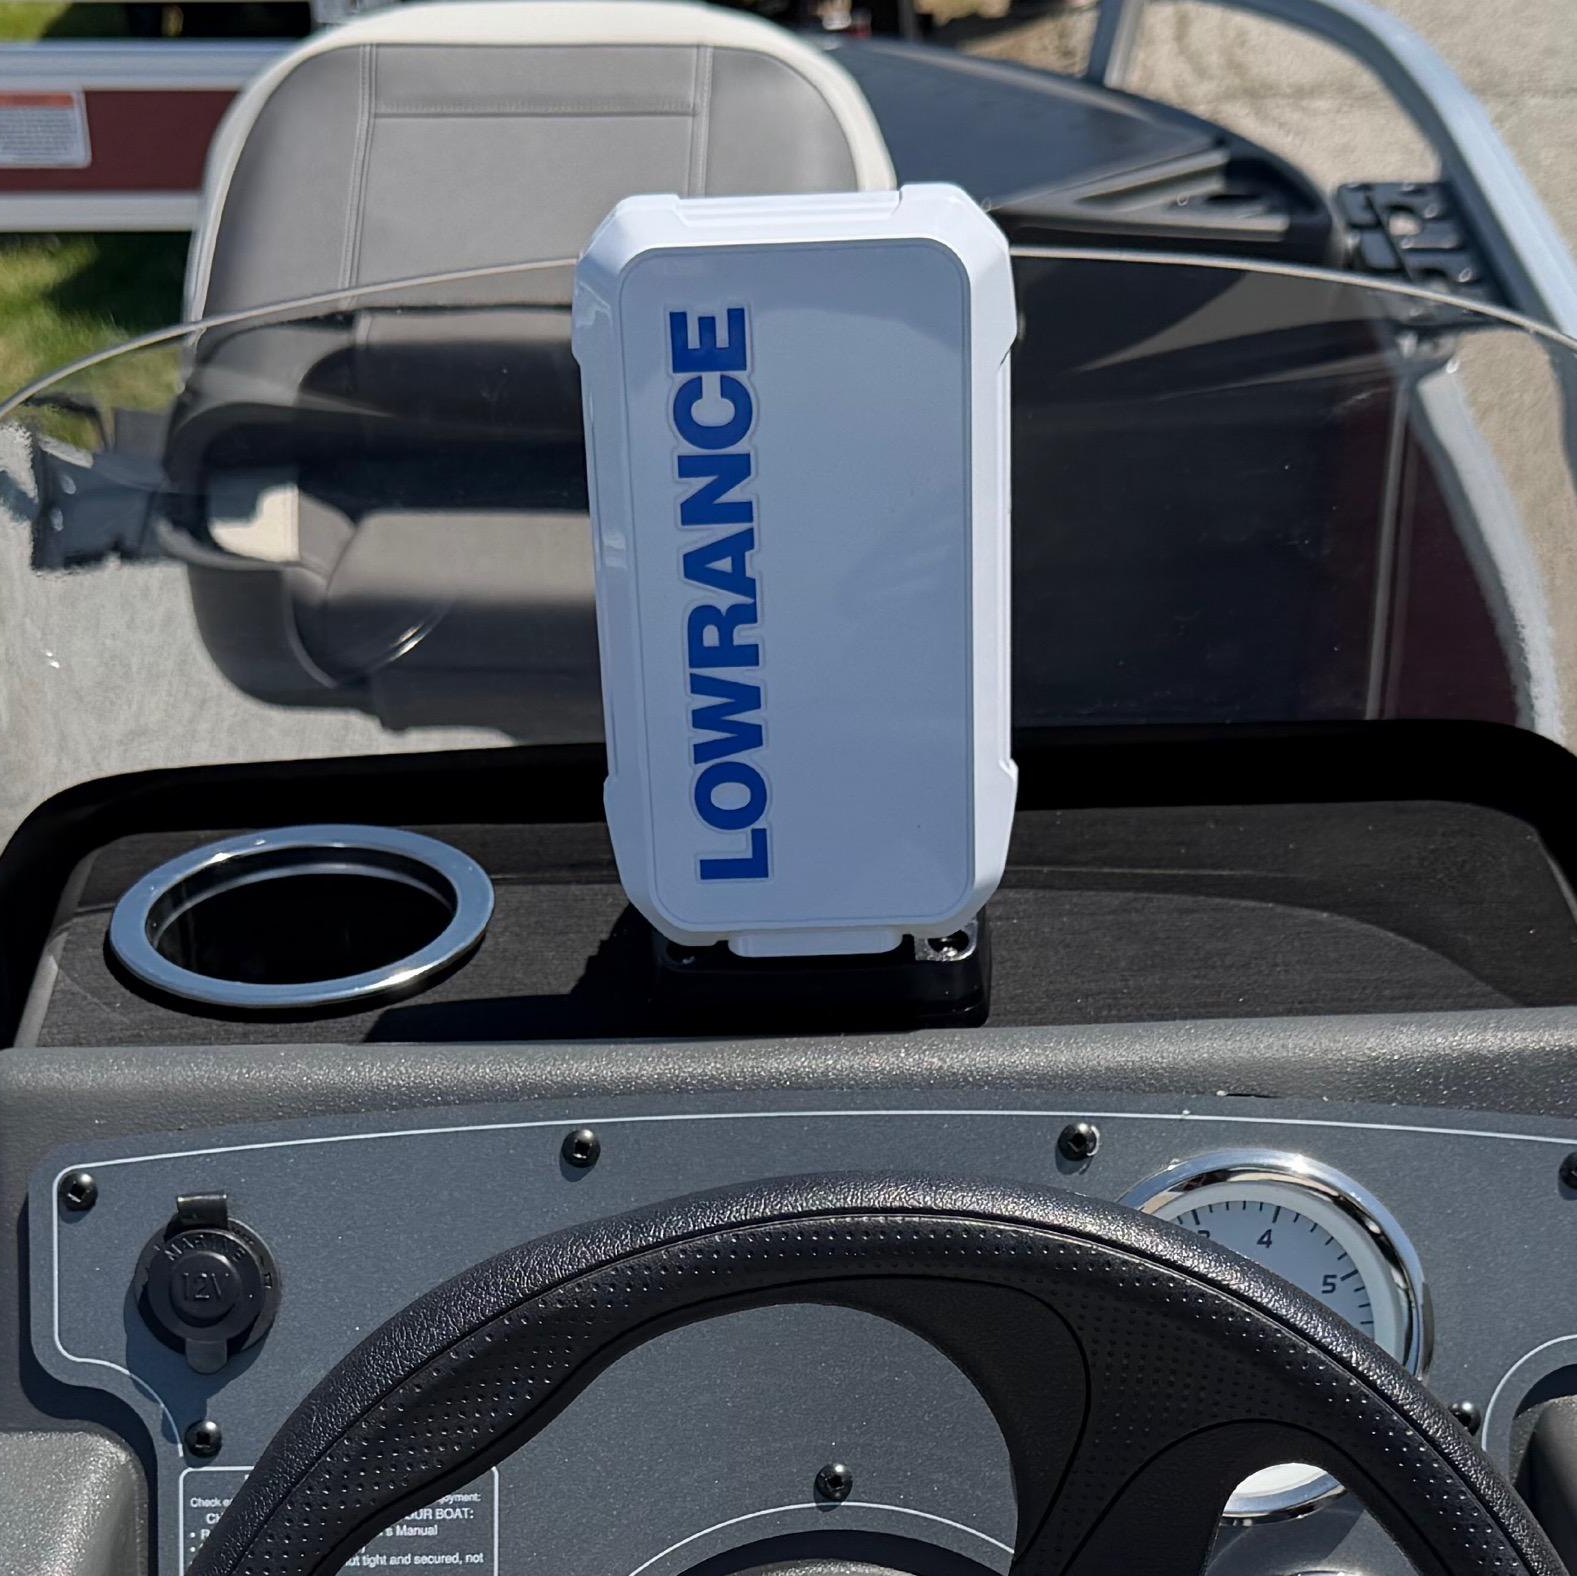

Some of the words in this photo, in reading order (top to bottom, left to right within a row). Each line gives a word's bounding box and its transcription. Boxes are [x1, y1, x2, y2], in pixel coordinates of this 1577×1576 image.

[669, 306, 770, 881] LOWRANCE
[1256, 1229, 1273, 1249] 4
[183, 1272, 230, 1301] 12V
[1321, 1274, 1338, 1294] 5
[190, 1497, 221, 1508] Check
[436, 1507, 474, 1519] BOAT:
[396, 1525, 438, 1536] Manual
[362, 1554, 387, 1568] tight
[389, 1553, 411, 1565] and
[413, 1552, 463, 1566] secured,
[465, 1552, 484, 1563] not
